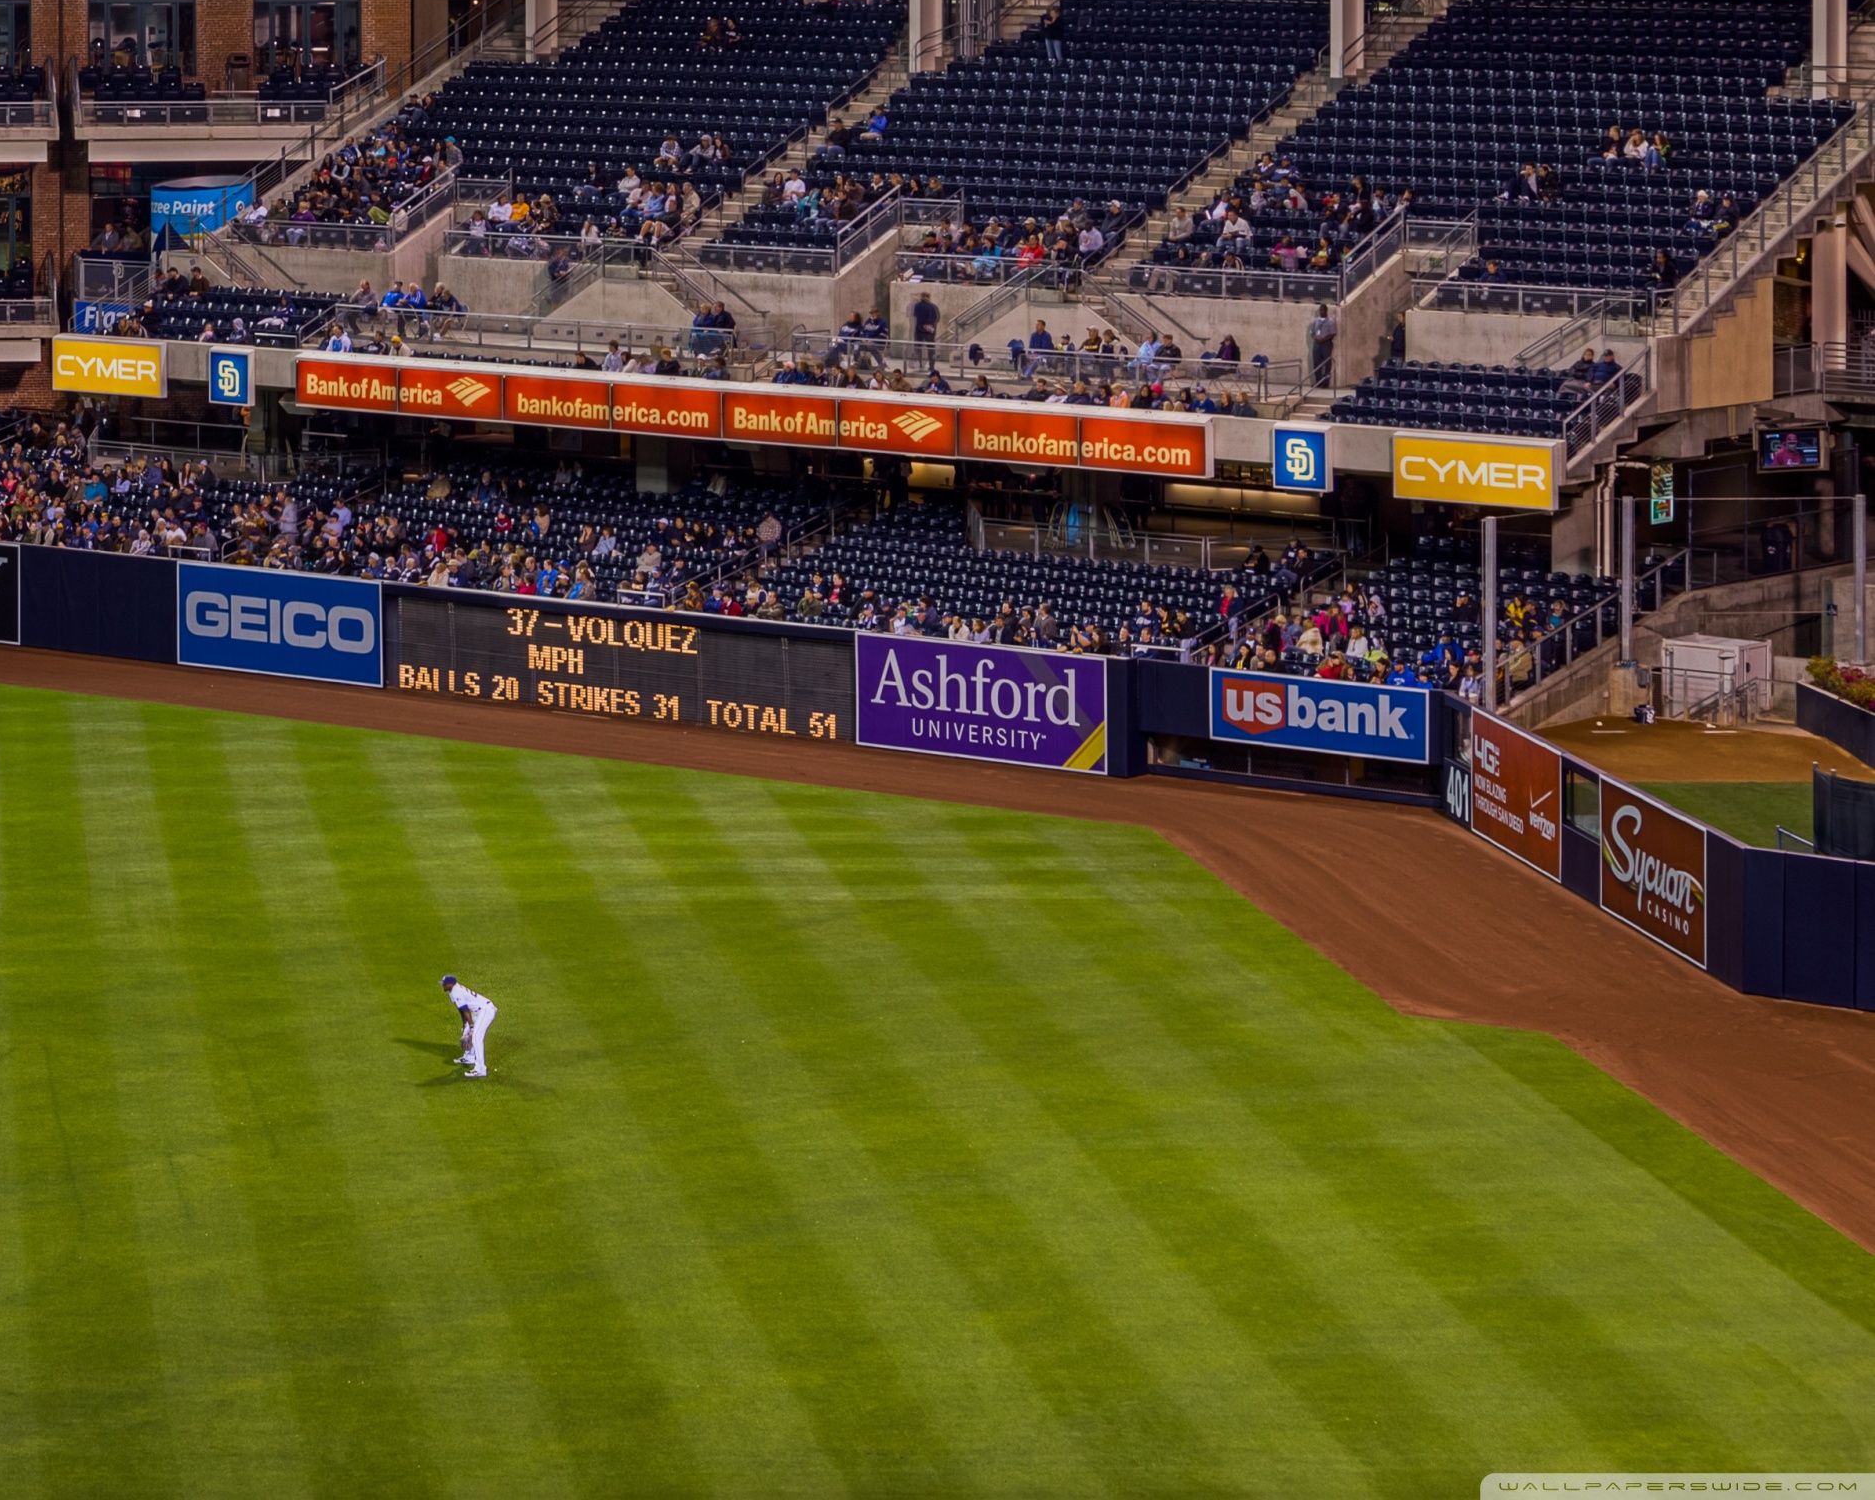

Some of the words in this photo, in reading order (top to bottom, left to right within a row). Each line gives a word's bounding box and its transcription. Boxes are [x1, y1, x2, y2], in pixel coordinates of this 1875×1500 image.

[172, 199, 216, 215] Paint
[57, 354, 156, 383] CYMER
[518, 393, 709, 428] bankofamerica.com
[973, 429, 1190, 466] bankofamerica.com
[1400, 456, 1546, 490] CYMER
[185, 591, 375, 654] GEICO
[528, 645, 584, 675] MPH
[871, 648, 1080, 727] Ashford
[492, 677, 519, 700] 20
[537, 681, 641, 717] STRIKES
[653, 695, 679, 720] 31
[707, 700, 796, 735] TOTAL
[809, 712, 836, 738] 51
[912, 717, 1041, 751] UNIVERSITY
[1447, 766, 1468, 822] 401
[1475, 772, 1486, 790] NOW
[1486, 778, 1506, 804] BLAZING
[1475, 792, 1497, 818] THROUGH
[1498, 806, 1508, 826] SAN
[1509, 812, 1523, 834] DIEGO
[1530, 811, 1555, 840] verizon
[1611, 805, 1694, 914] Sycuan
[1647, 899, 1689, 935] CASINO
